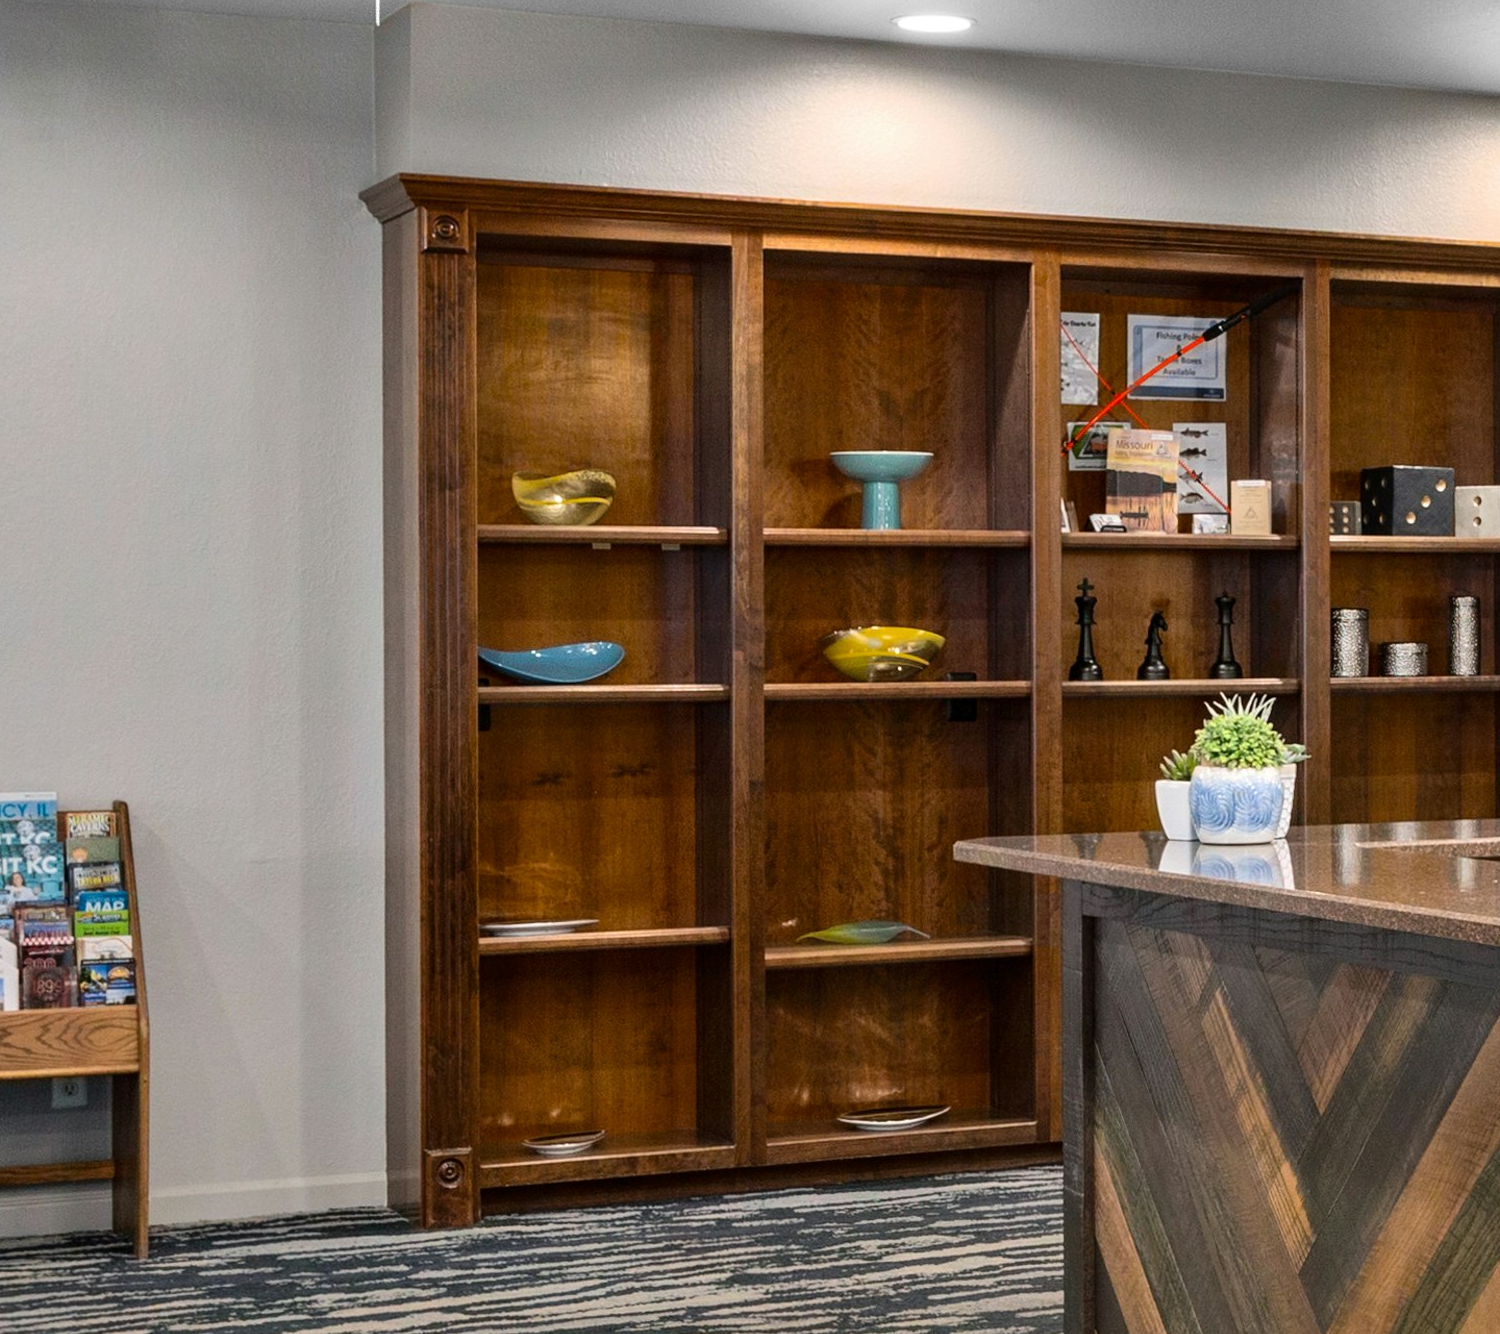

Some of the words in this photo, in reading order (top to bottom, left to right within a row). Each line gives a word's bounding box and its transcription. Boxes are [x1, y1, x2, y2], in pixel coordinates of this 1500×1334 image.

[1156, 332, 1182, 341] Fishing
[1163, 368, 1196, 377] Available
[36, 803, 50, 818] IL
[20, 832, 51, 845] KC
[27, 855, 58, 875] KC
[85, 901, 125, 912] MAP
